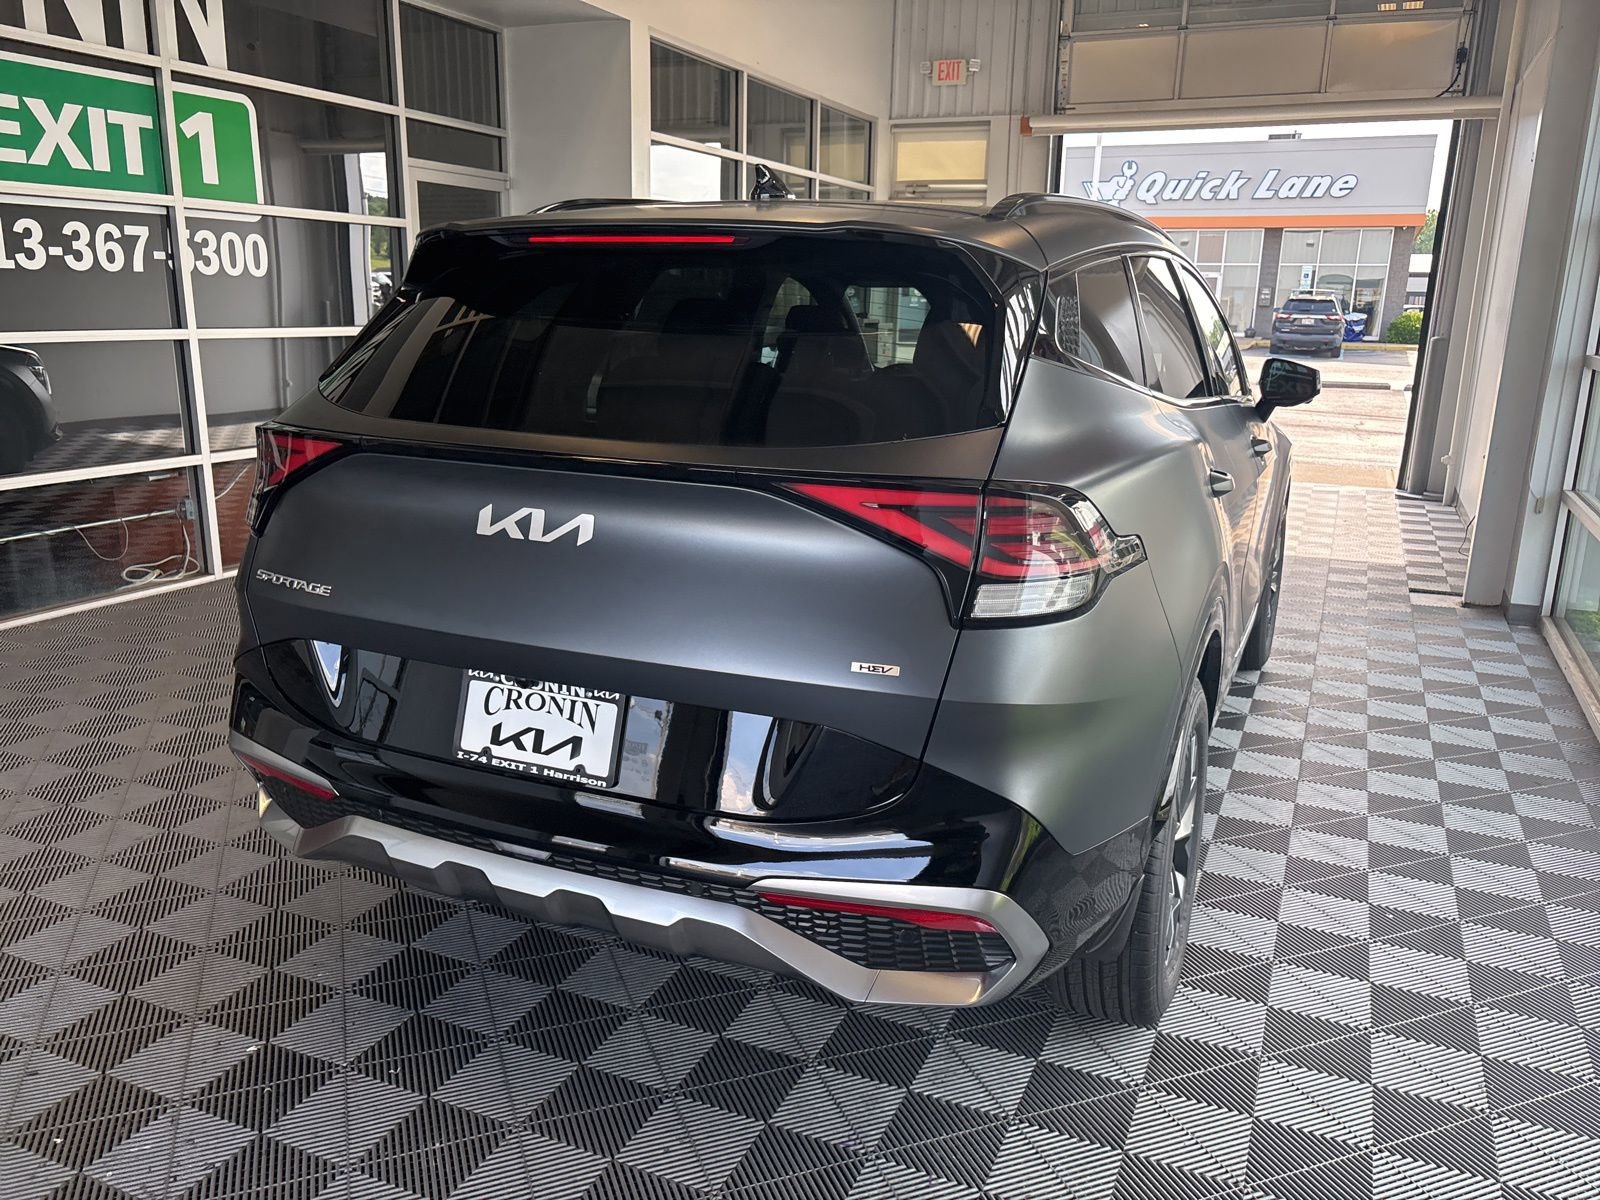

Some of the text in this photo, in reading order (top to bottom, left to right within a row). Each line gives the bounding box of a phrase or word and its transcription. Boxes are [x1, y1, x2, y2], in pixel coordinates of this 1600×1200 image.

[937, 60, 962, 81] EXIT
[179, 111, 220, 185] 1
[1136, 168, 1359, 205] Quick Lane
[475, 503, 595, 547] KIA
[256, 568, 332, 597] SPORTAGE
[500, 674, 586, 698] CNIN
[859, 663, 893, 674] HEV
[483, 685, 600, 735] CRONIN
[489, 722, 583, 761] KIA
[456, 750, 607, 788] I-74 EXIT 1 Harrison
